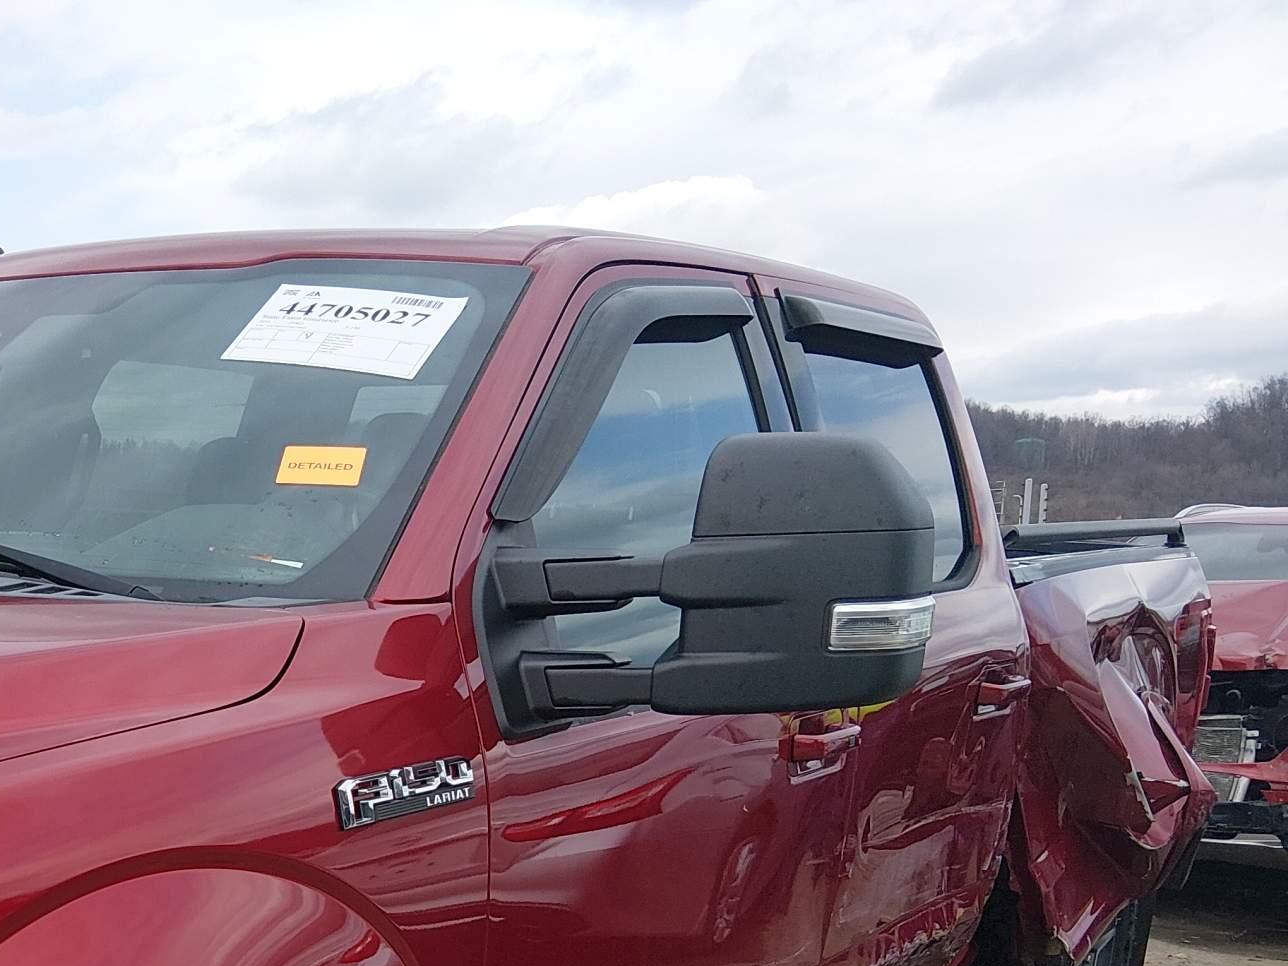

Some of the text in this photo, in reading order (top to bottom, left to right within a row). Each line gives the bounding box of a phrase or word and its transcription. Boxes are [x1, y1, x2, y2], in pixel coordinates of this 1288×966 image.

[279, 302, 432, 327] 44705027
[287, 462, 354, 471] DETAILED
[426, 787, 471, 807] LARIAT
